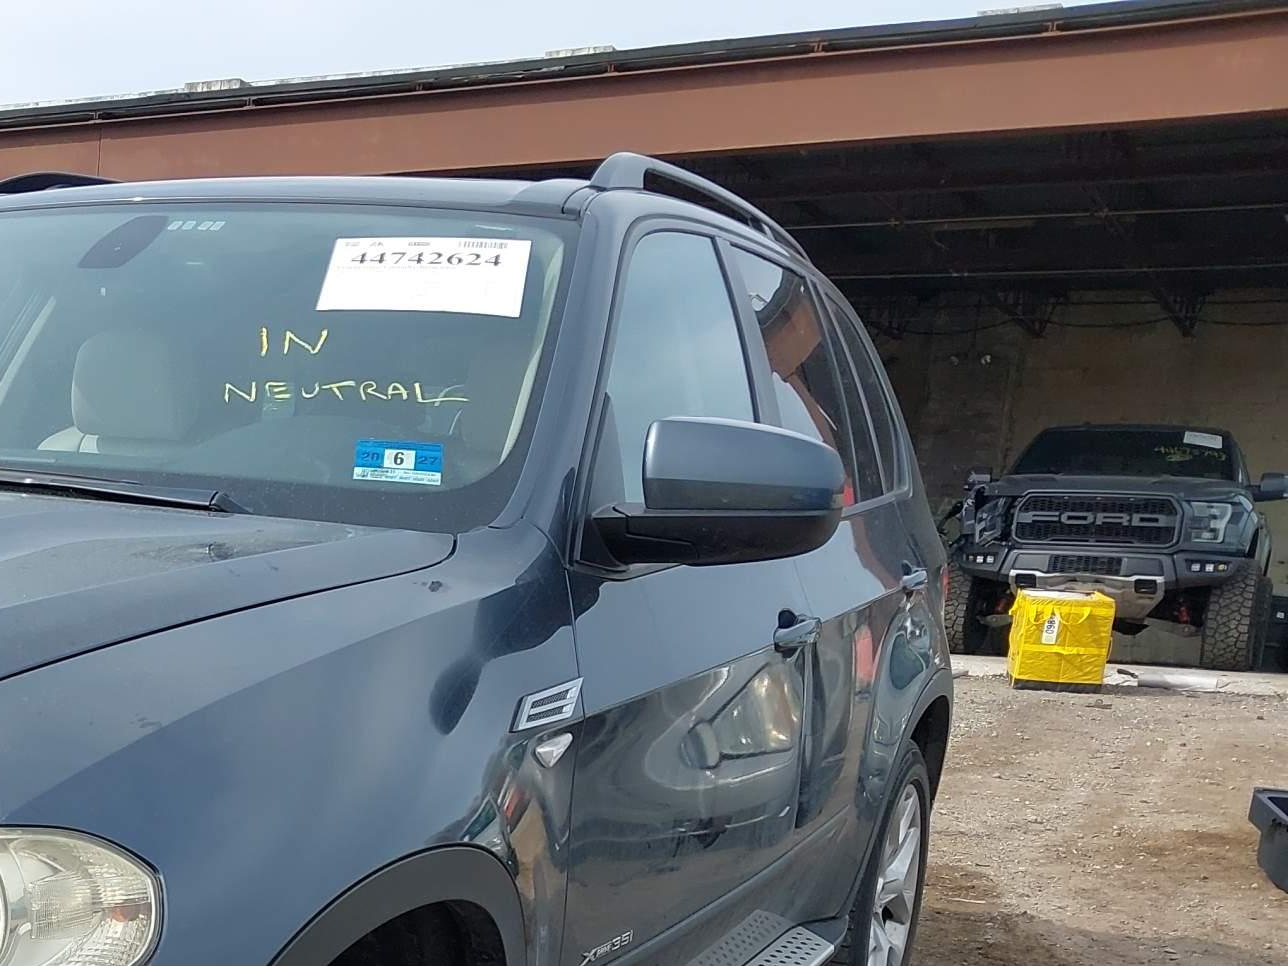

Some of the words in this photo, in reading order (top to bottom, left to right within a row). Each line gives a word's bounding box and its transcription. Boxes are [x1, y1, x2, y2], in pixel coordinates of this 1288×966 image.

[351, 252, 502, 267] 44742624
[261, 327, 329, 357] IN
[224, 380, 470, 404] NEUTRAL
[393, 451, 404, 466] 6
[1017, 511, 1176, 526] FORD
